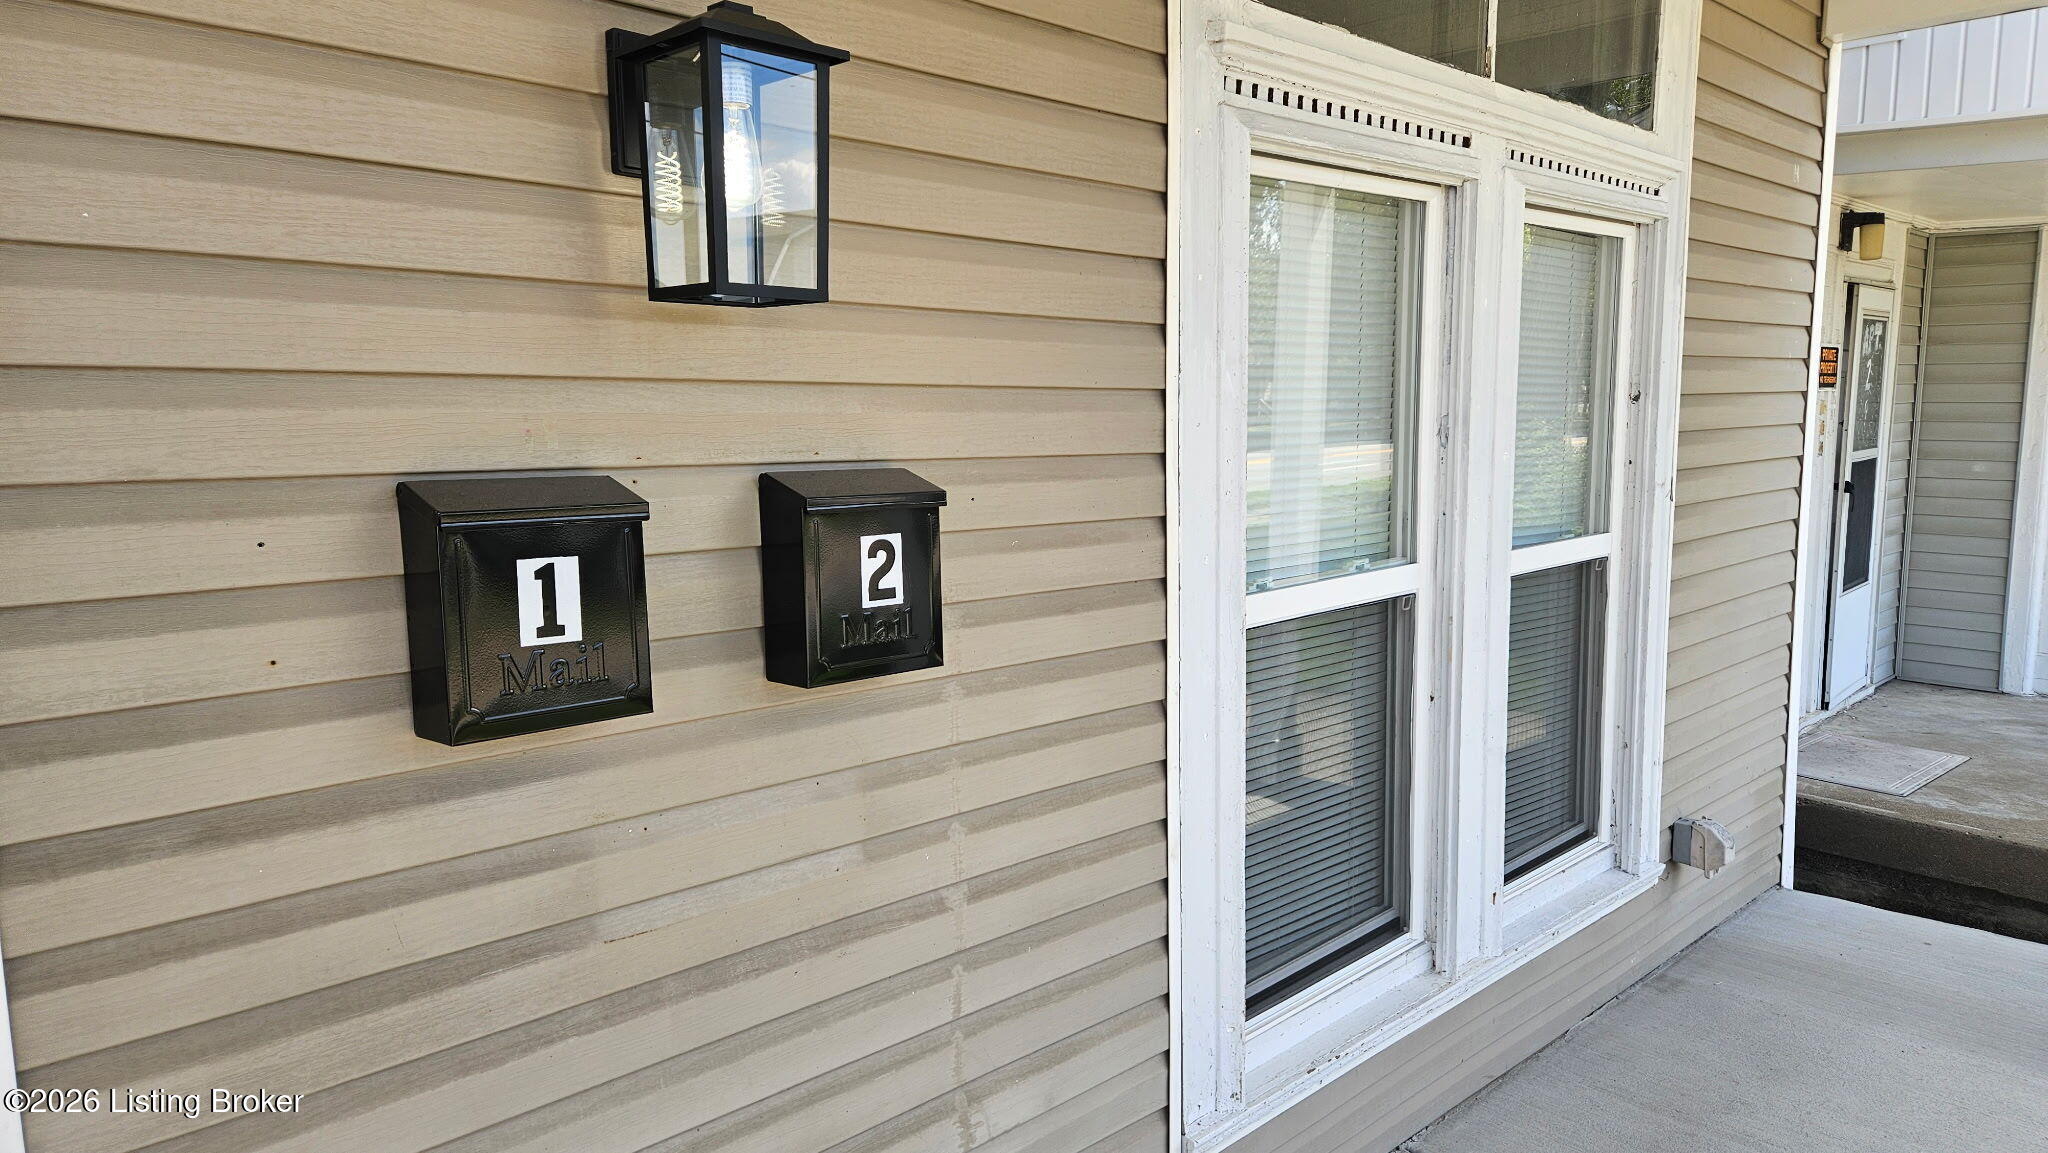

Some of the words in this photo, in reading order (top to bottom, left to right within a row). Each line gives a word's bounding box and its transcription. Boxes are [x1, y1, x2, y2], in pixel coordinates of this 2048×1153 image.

[866, 539, 897, 602] 2
[533, 562, 566, 640] 1
[840, 608, 918, 649] Mail
[498, 643, 611, 697] Mail
